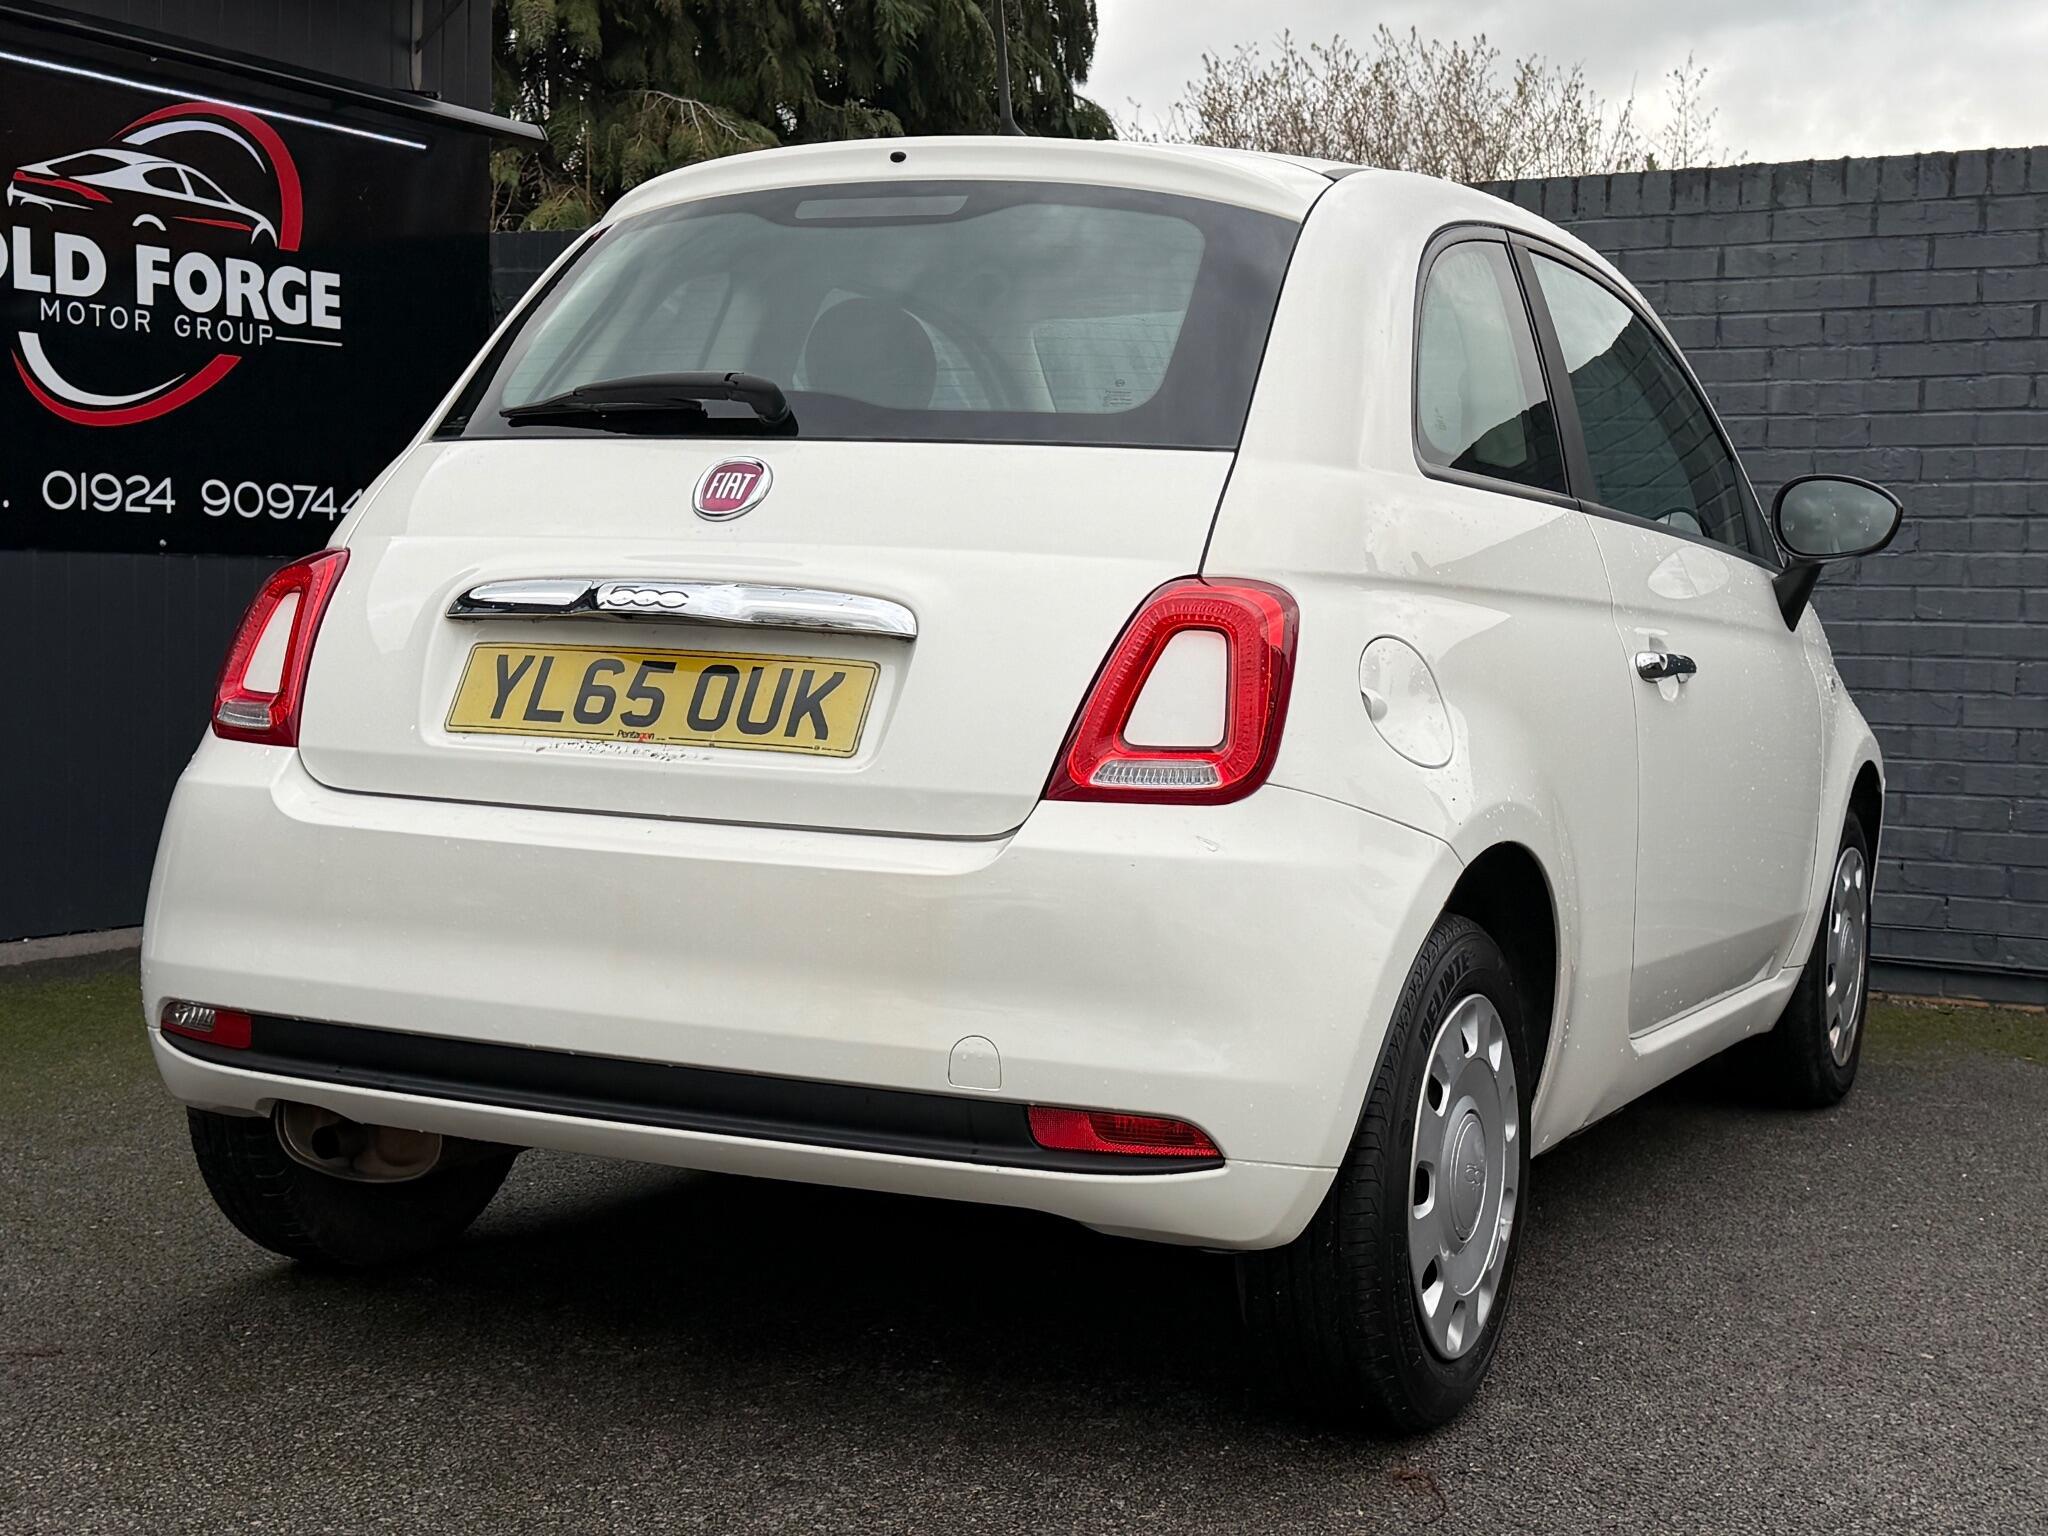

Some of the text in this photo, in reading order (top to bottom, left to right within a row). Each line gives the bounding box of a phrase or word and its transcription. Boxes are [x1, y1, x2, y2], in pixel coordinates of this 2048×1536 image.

[0, 226, 342, 330] LD FORGE
[40, 297, 274, 346] MOTOR GROUP
[42, 470, 176, 514] 01924
[706, 472, 756, 500] FIAT
[606, 585, 689, 609] 500
[490, 654, 846, 741] YL65 OUK
[616, 730, 655, 742] Pentagon
